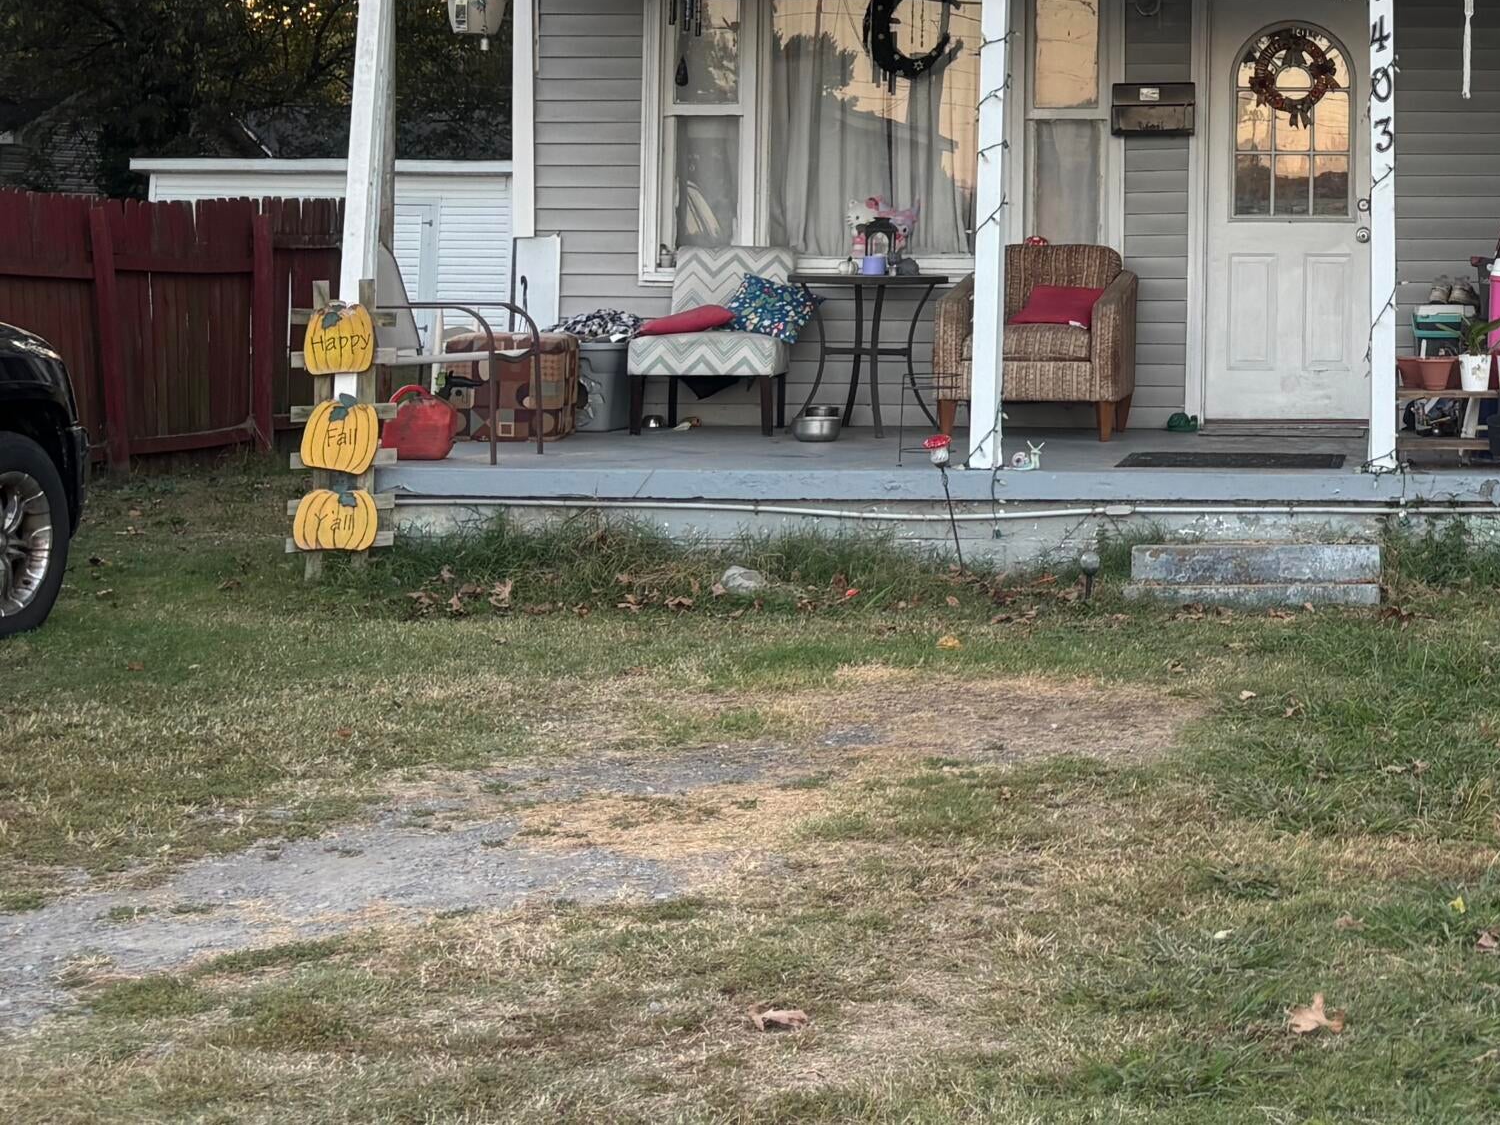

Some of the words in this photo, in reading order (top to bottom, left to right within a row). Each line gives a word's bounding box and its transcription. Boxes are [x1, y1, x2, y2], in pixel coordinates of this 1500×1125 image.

[310, 332, 371, 354] Happy
[326, 428, 358, 447] Fall
[314, 510, 354, 533] Y'all
